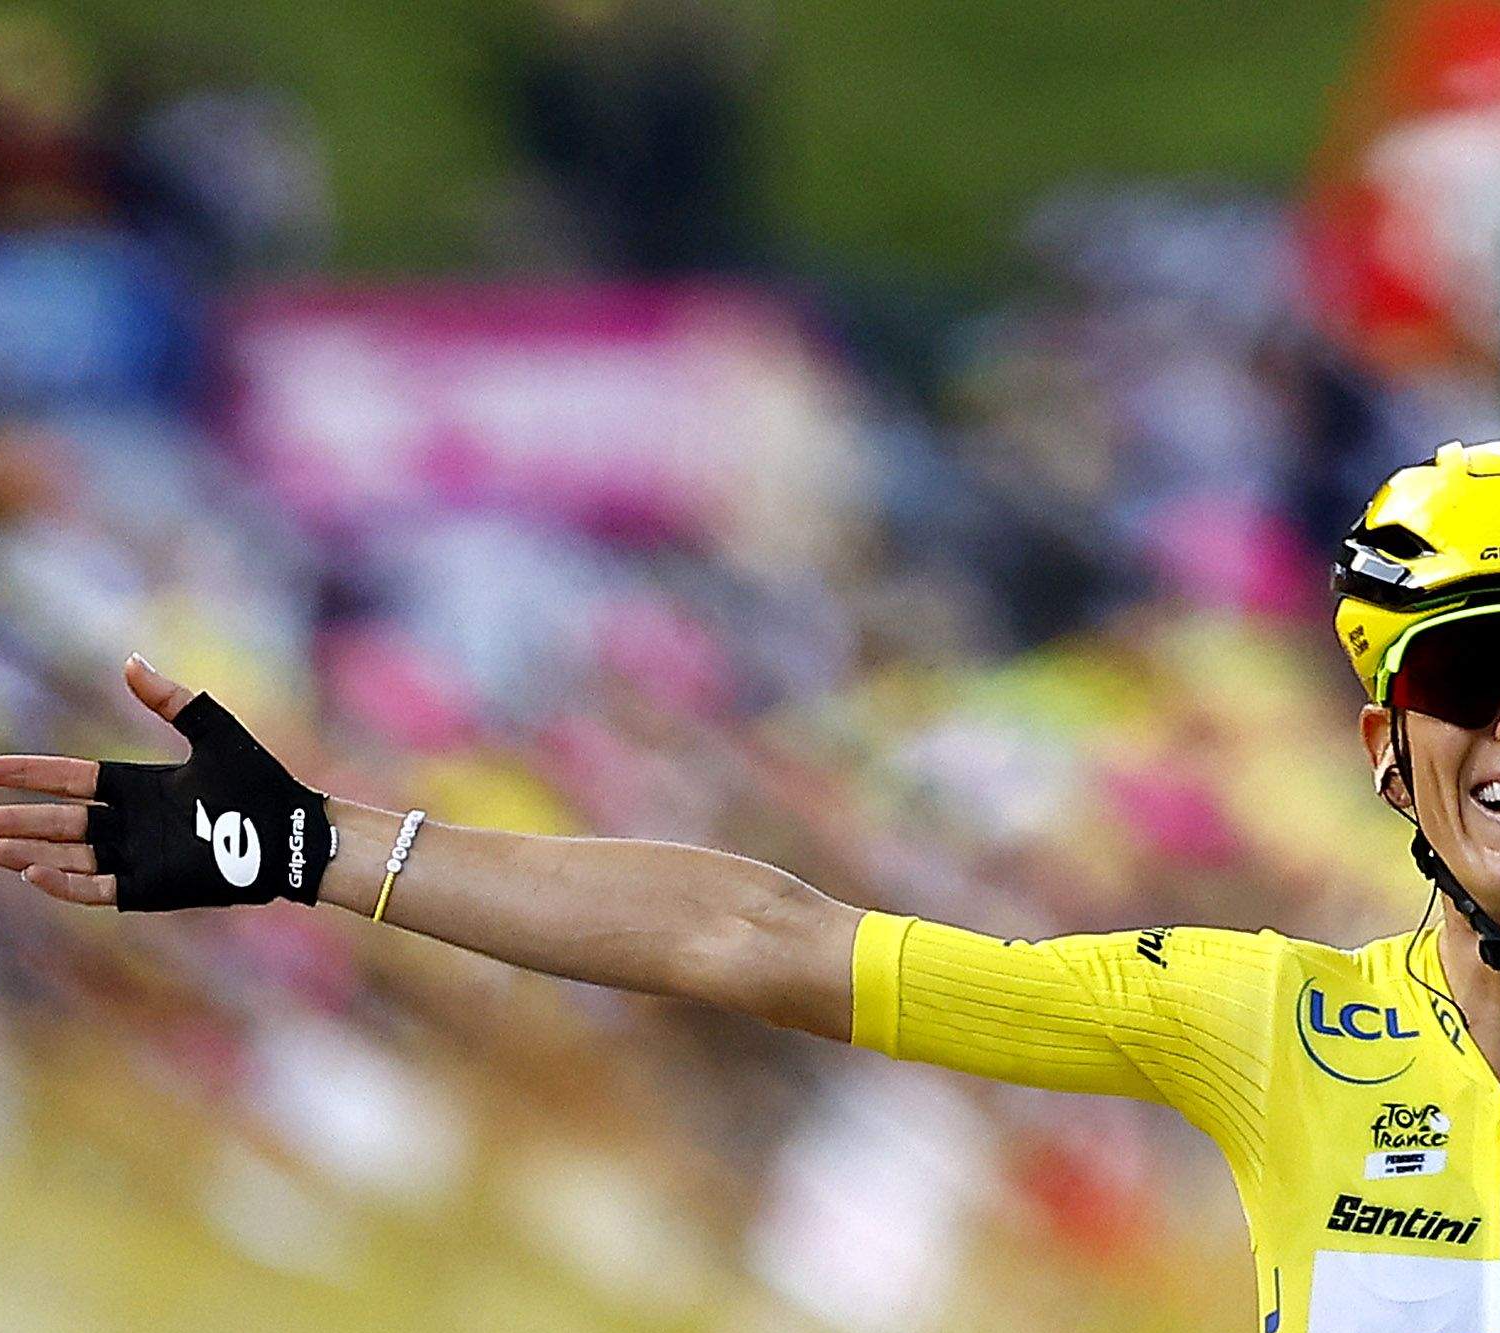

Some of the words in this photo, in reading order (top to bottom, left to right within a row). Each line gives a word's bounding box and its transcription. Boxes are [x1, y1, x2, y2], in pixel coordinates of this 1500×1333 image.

[288, 808, 306, 888] GripGrab
[1310, 989, 1420, 1040] LCL
[1327, 1194, 1481, 1244] Santini
